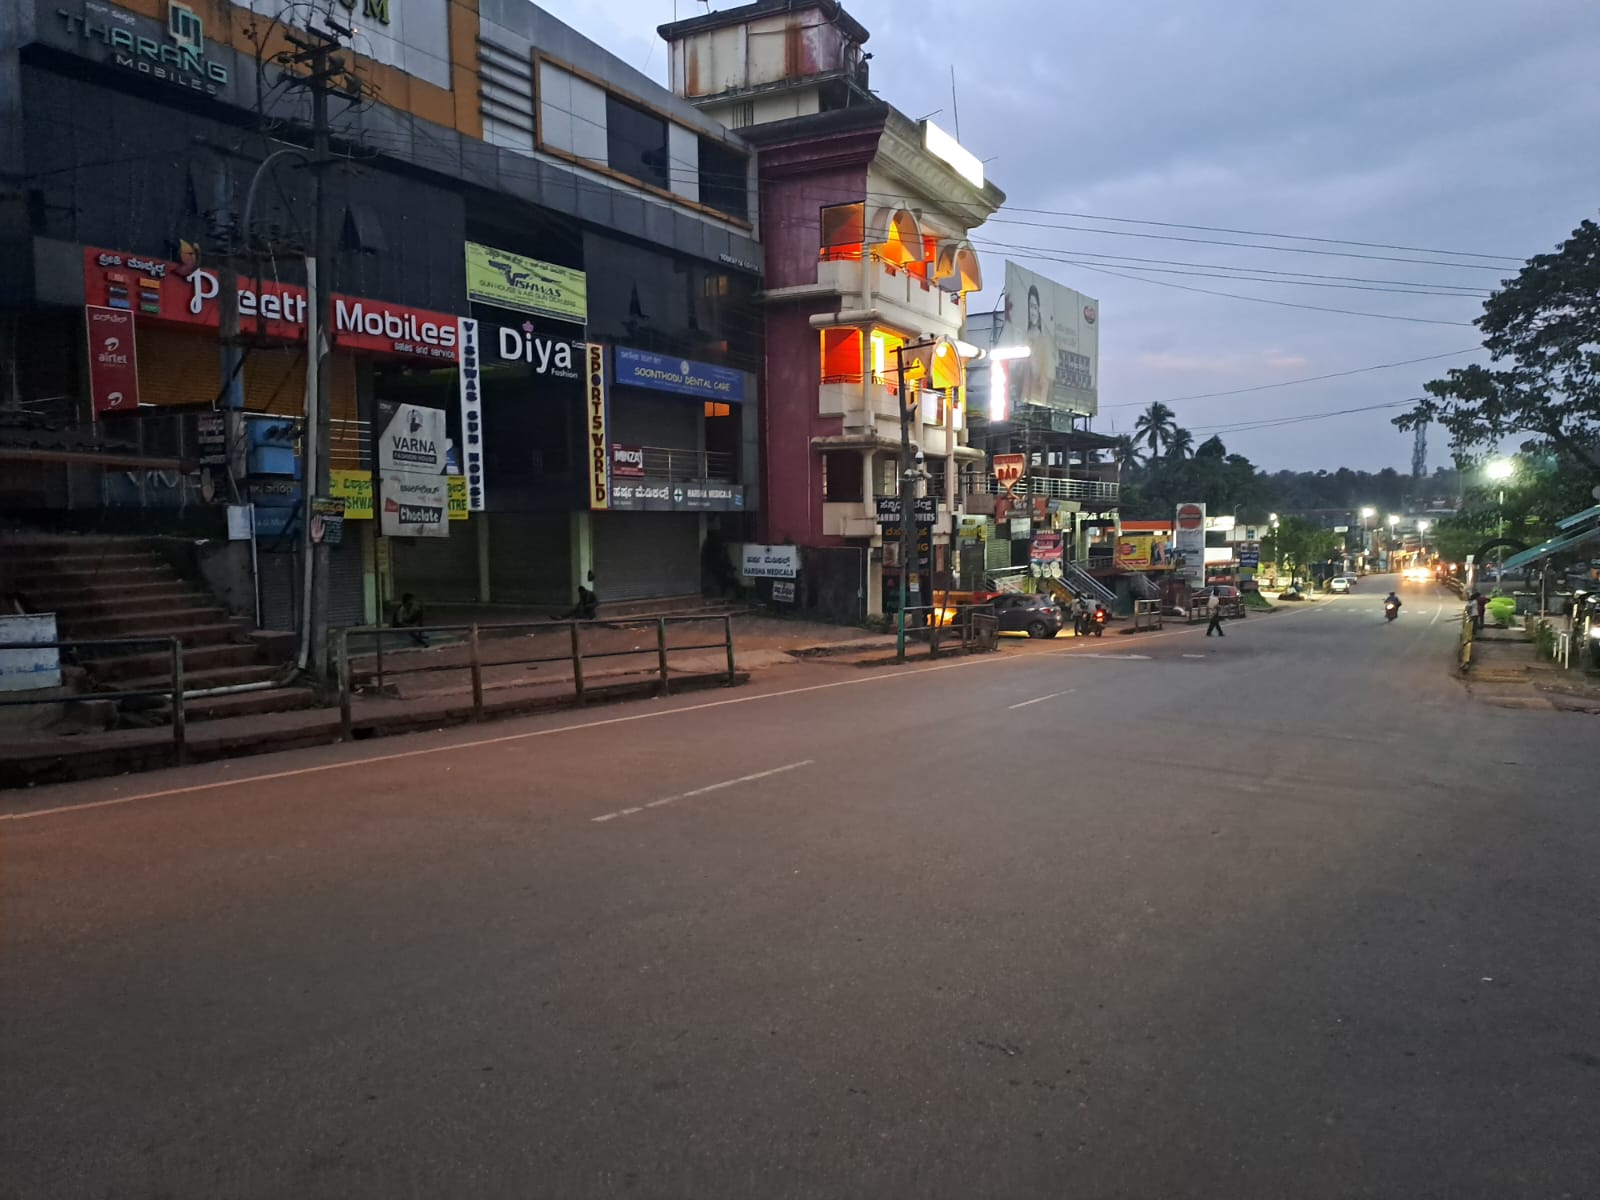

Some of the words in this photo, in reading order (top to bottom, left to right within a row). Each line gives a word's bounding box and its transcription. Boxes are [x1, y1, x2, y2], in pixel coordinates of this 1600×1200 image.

[57, 8, 228, 84] THARANG
[116, 54, 217, 95] MOBILES
[335, 299, 456, 347] Mobiles
[464, 321, 478, 402] VISHWAS
[499, 326, 572, 374] Diya
[590, 347, 602, 429] SPORTS
[392, 435, 437, 454] VARNA
[592, 433, 606, 501] WORLD
[743, 567, 766, 575] HARSHA
[766, 567, 794, 576] MEDICALS
